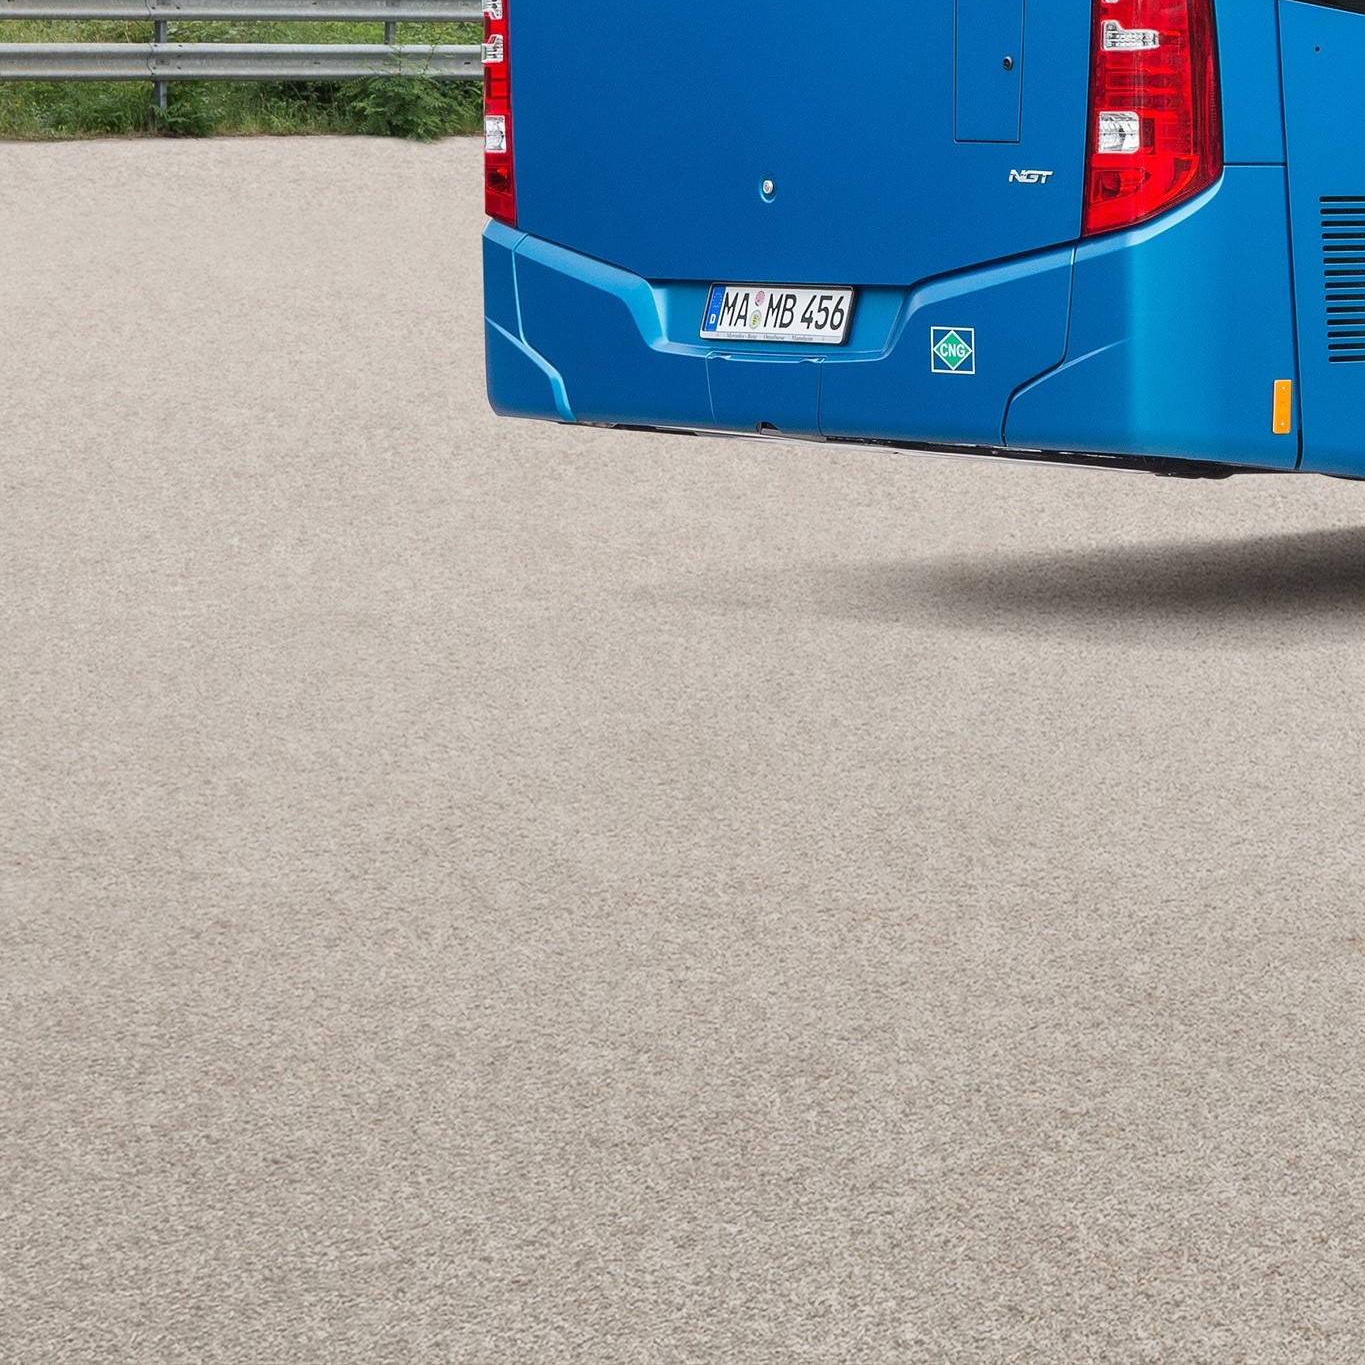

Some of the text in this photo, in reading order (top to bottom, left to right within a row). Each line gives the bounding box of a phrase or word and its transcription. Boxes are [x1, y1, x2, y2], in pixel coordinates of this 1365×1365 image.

[1008, 169, 1053, 184] NGT
[709, 314, 716, 324] D
[719, 292, 845, 331] MA MB 456
[940, 342, 966, 357] CNG
